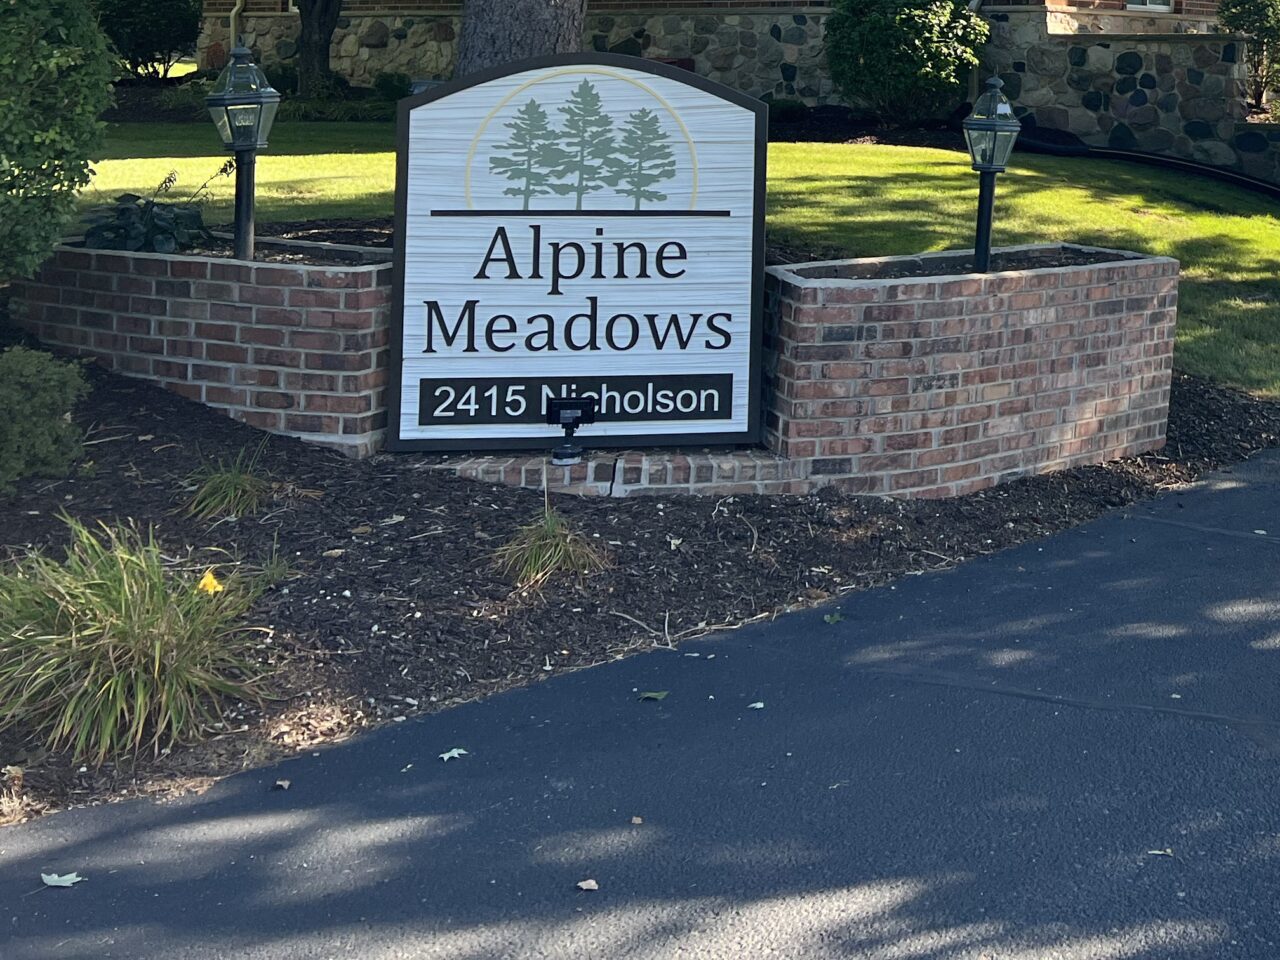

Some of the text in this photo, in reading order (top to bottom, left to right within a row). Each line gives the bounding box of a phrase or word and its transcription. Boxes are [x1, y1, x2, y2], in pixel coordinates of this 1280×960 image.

[473, 224, 688, 296] Alpine
[422, 296, 732, 354] Meadows
[433, 385, 527, 417] 2415
